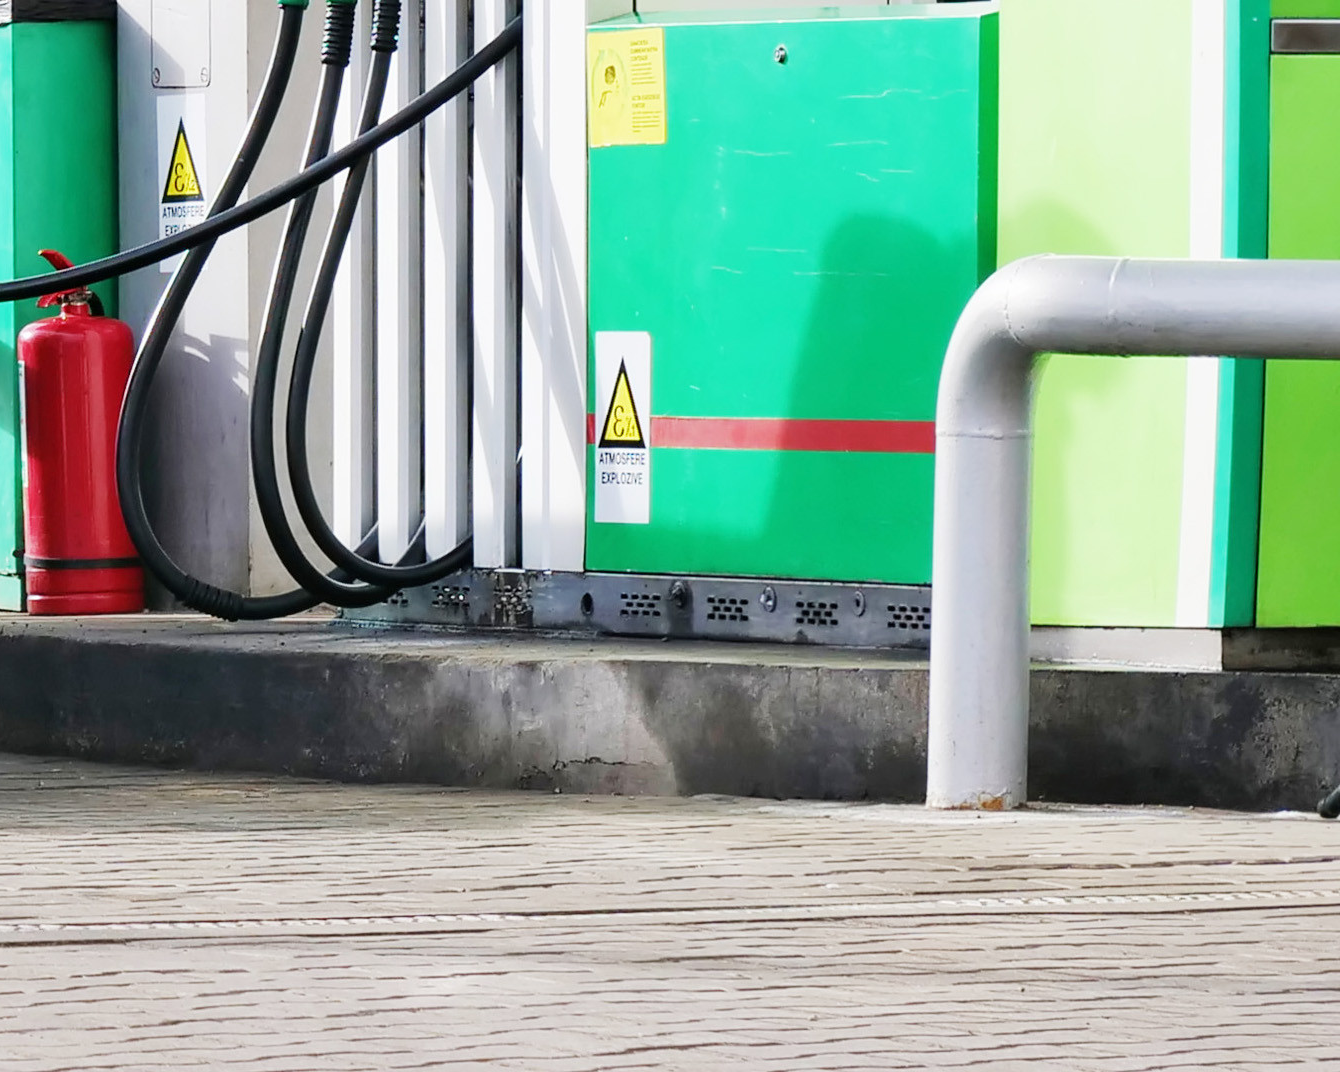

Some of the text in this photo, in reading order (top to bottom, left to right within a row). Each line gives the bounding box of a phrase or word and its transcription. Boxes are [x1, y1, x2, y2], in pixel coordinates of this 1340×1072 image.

[162, 205, 205, 219] ATMOSFERE
[599, 452, 646, 465] ATMOSFERE
[601, 471, 643, 484] EXPLOZIVE
